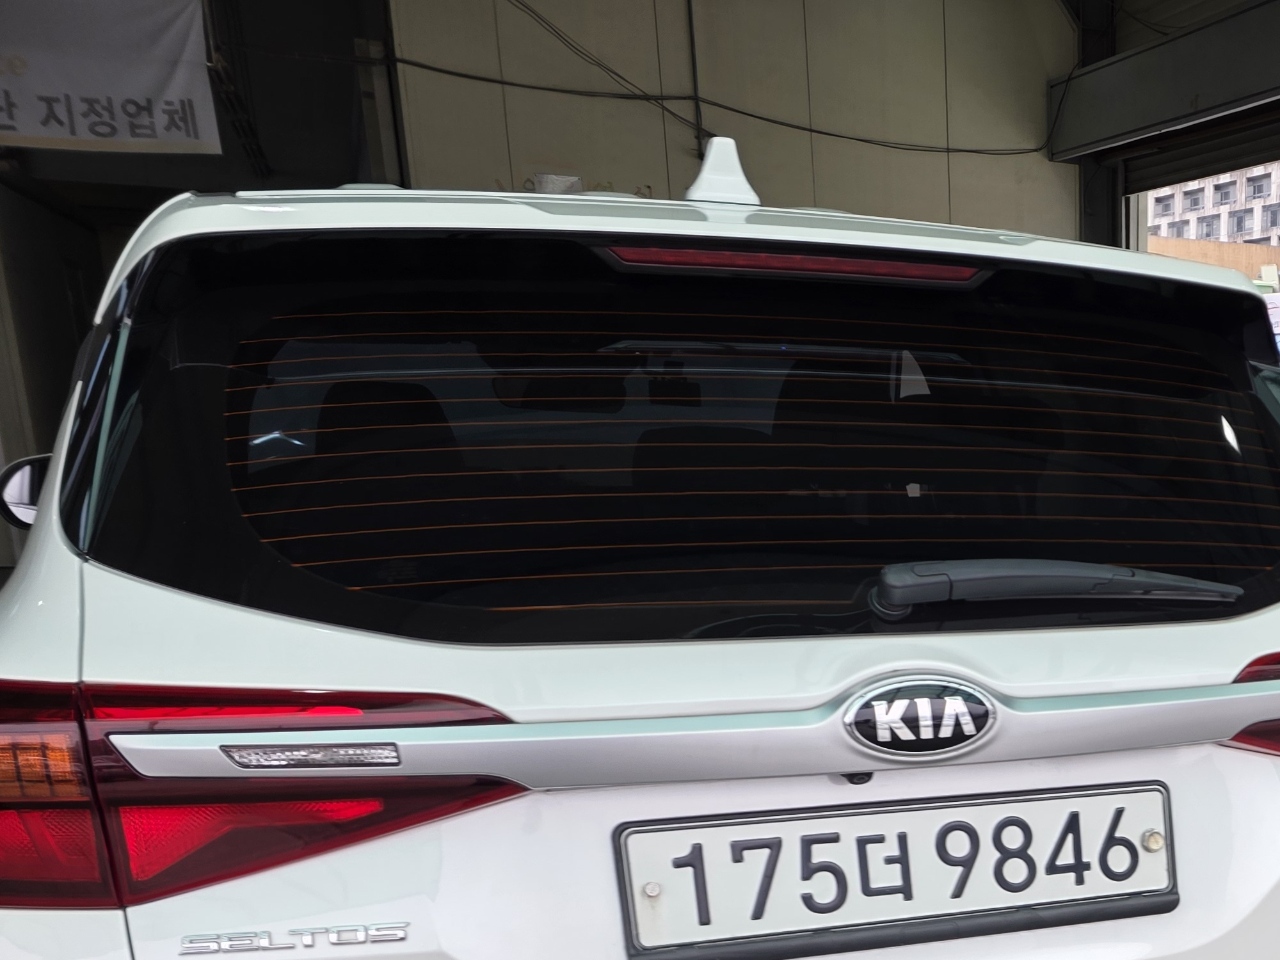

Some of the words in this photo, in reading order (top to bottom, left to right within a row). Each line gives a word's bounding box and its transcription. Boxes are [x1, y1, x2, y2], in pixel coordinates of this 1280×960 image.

[36, 93, 200, 140] 지정업체
[870, 695, 977, 742] KIA
[672, 807, 1139, 926] 175더9846
[178, 921, 411, 956] SELTOS
